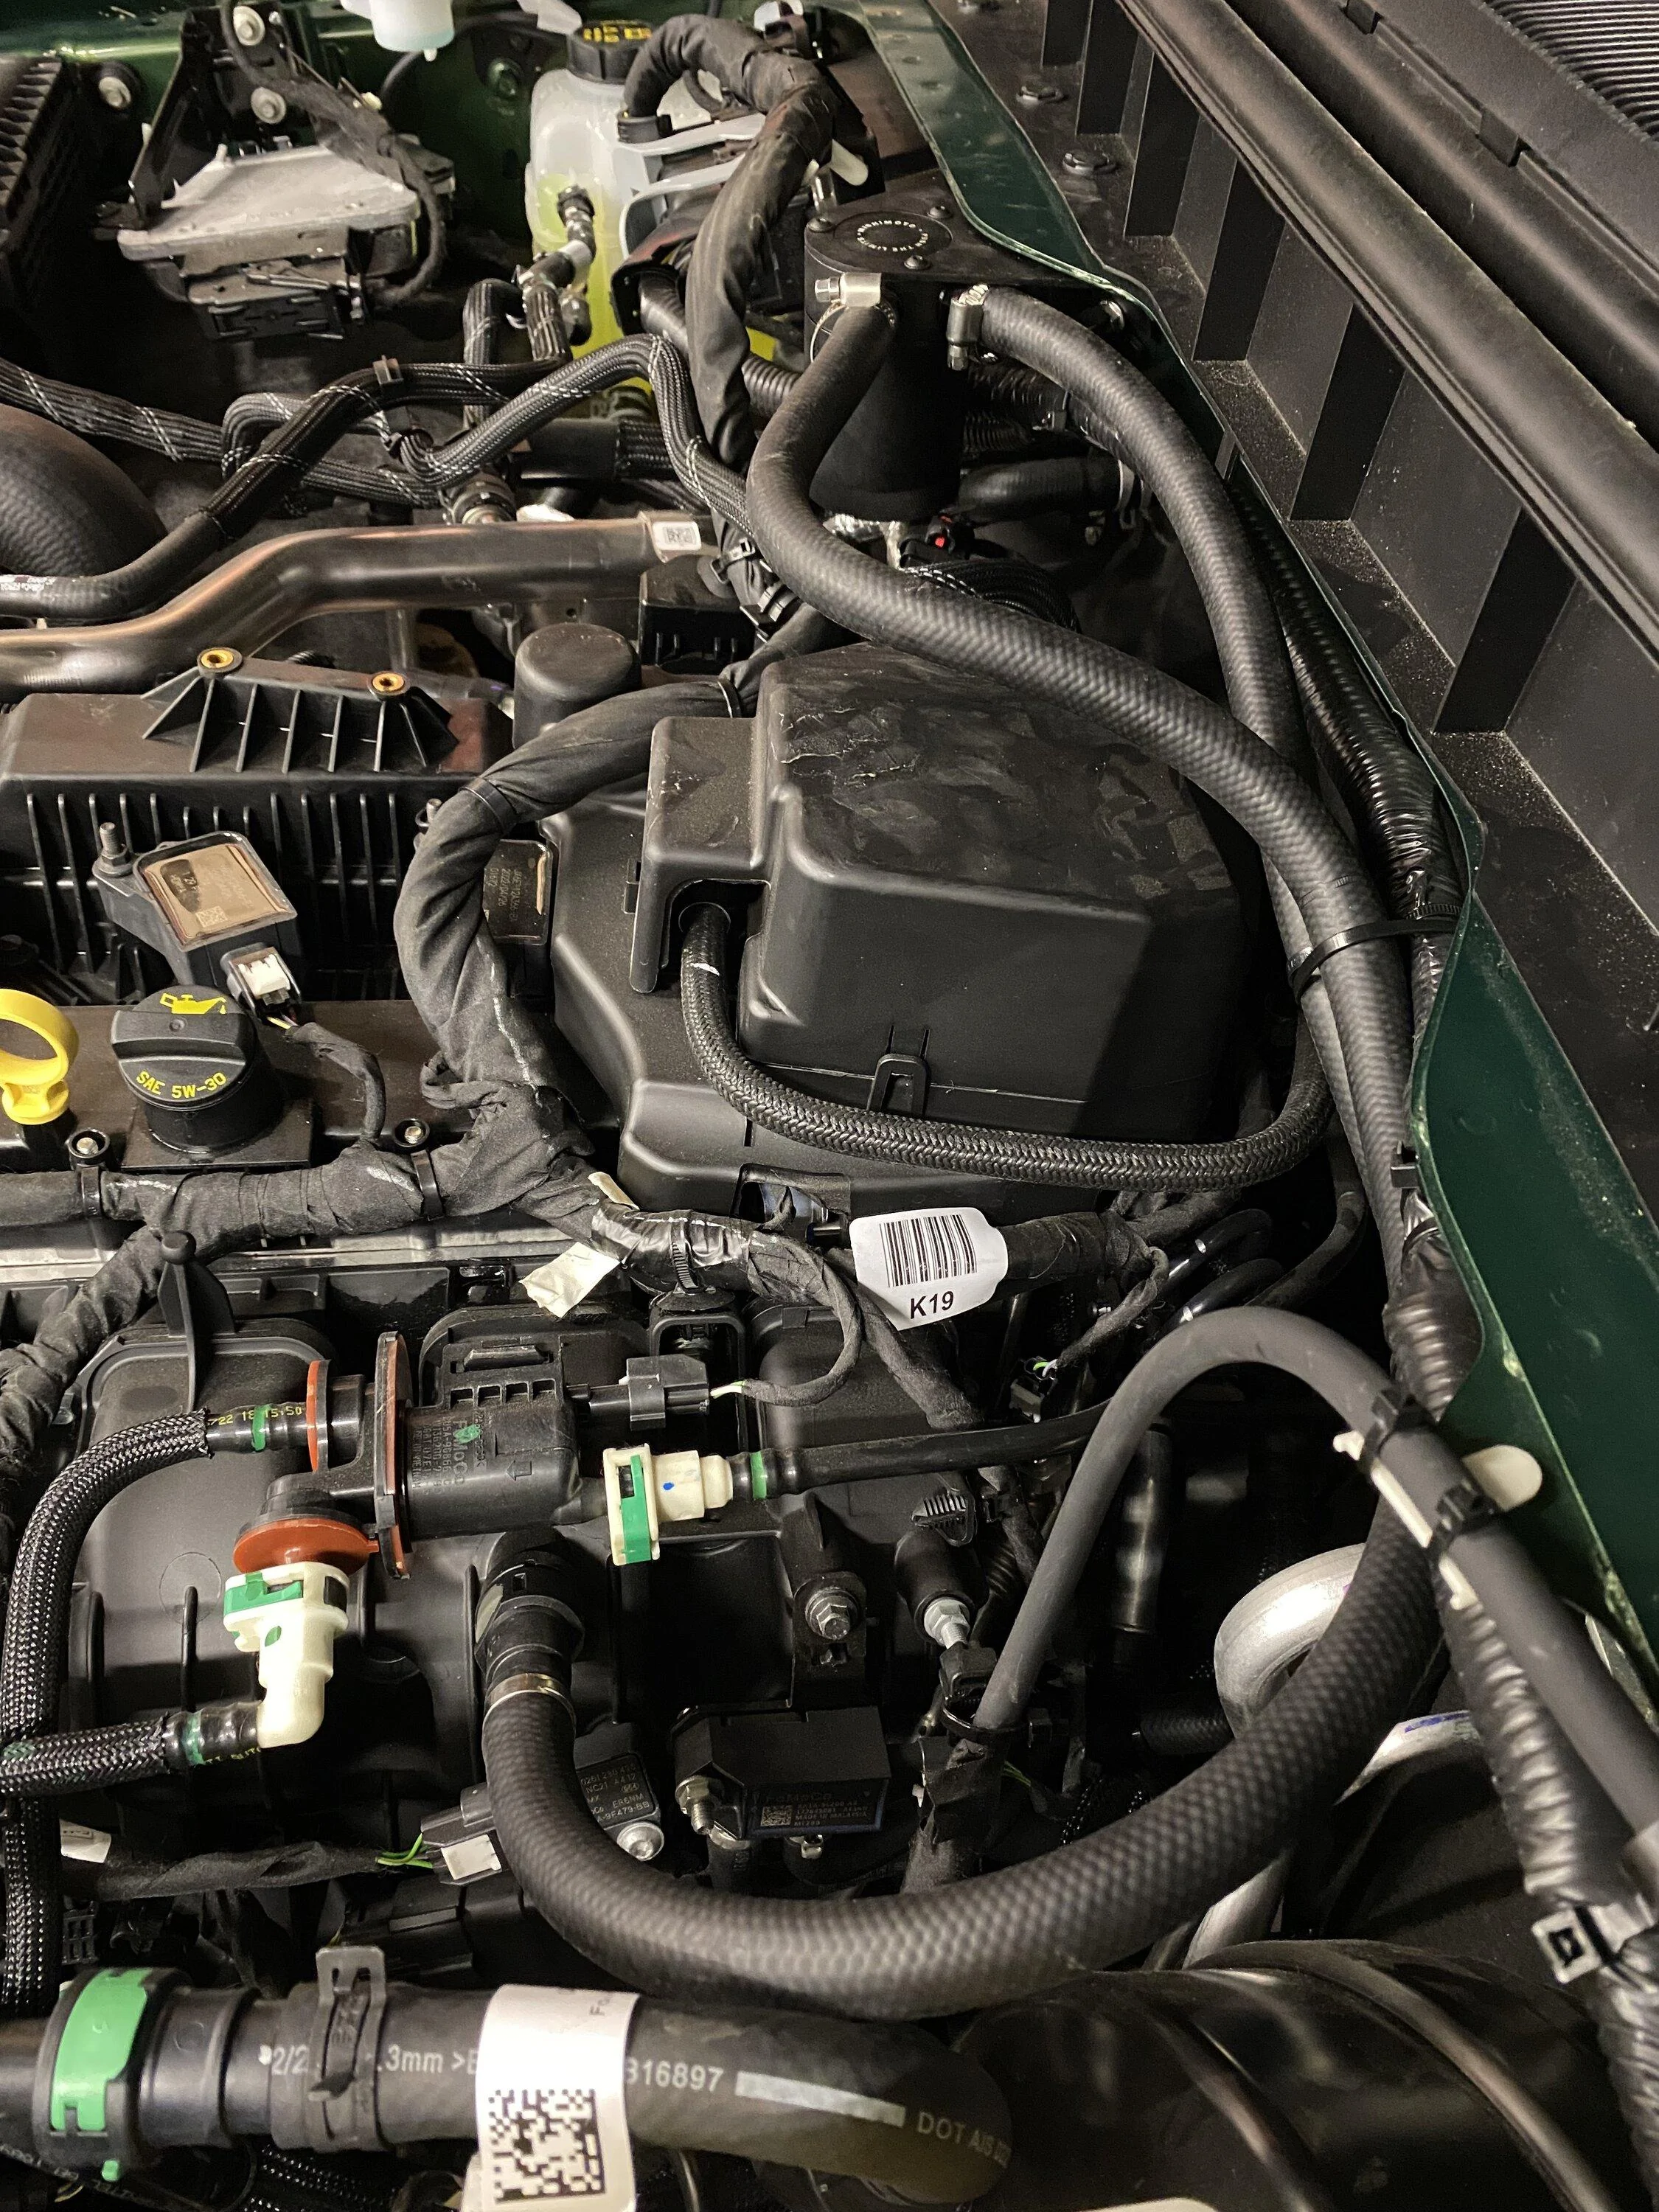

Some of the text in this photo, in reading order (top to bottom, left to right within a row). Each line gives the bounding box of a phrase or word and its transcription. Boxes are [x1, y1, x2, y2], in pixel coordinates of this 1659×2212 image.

[136, 1070, 227, 1099] SAE 5W-30
[910, 1290, 954, 1319] K19
[452, 1419, 468, 1485] FMoCo
[917, 2110, 966, 2145] DOT
